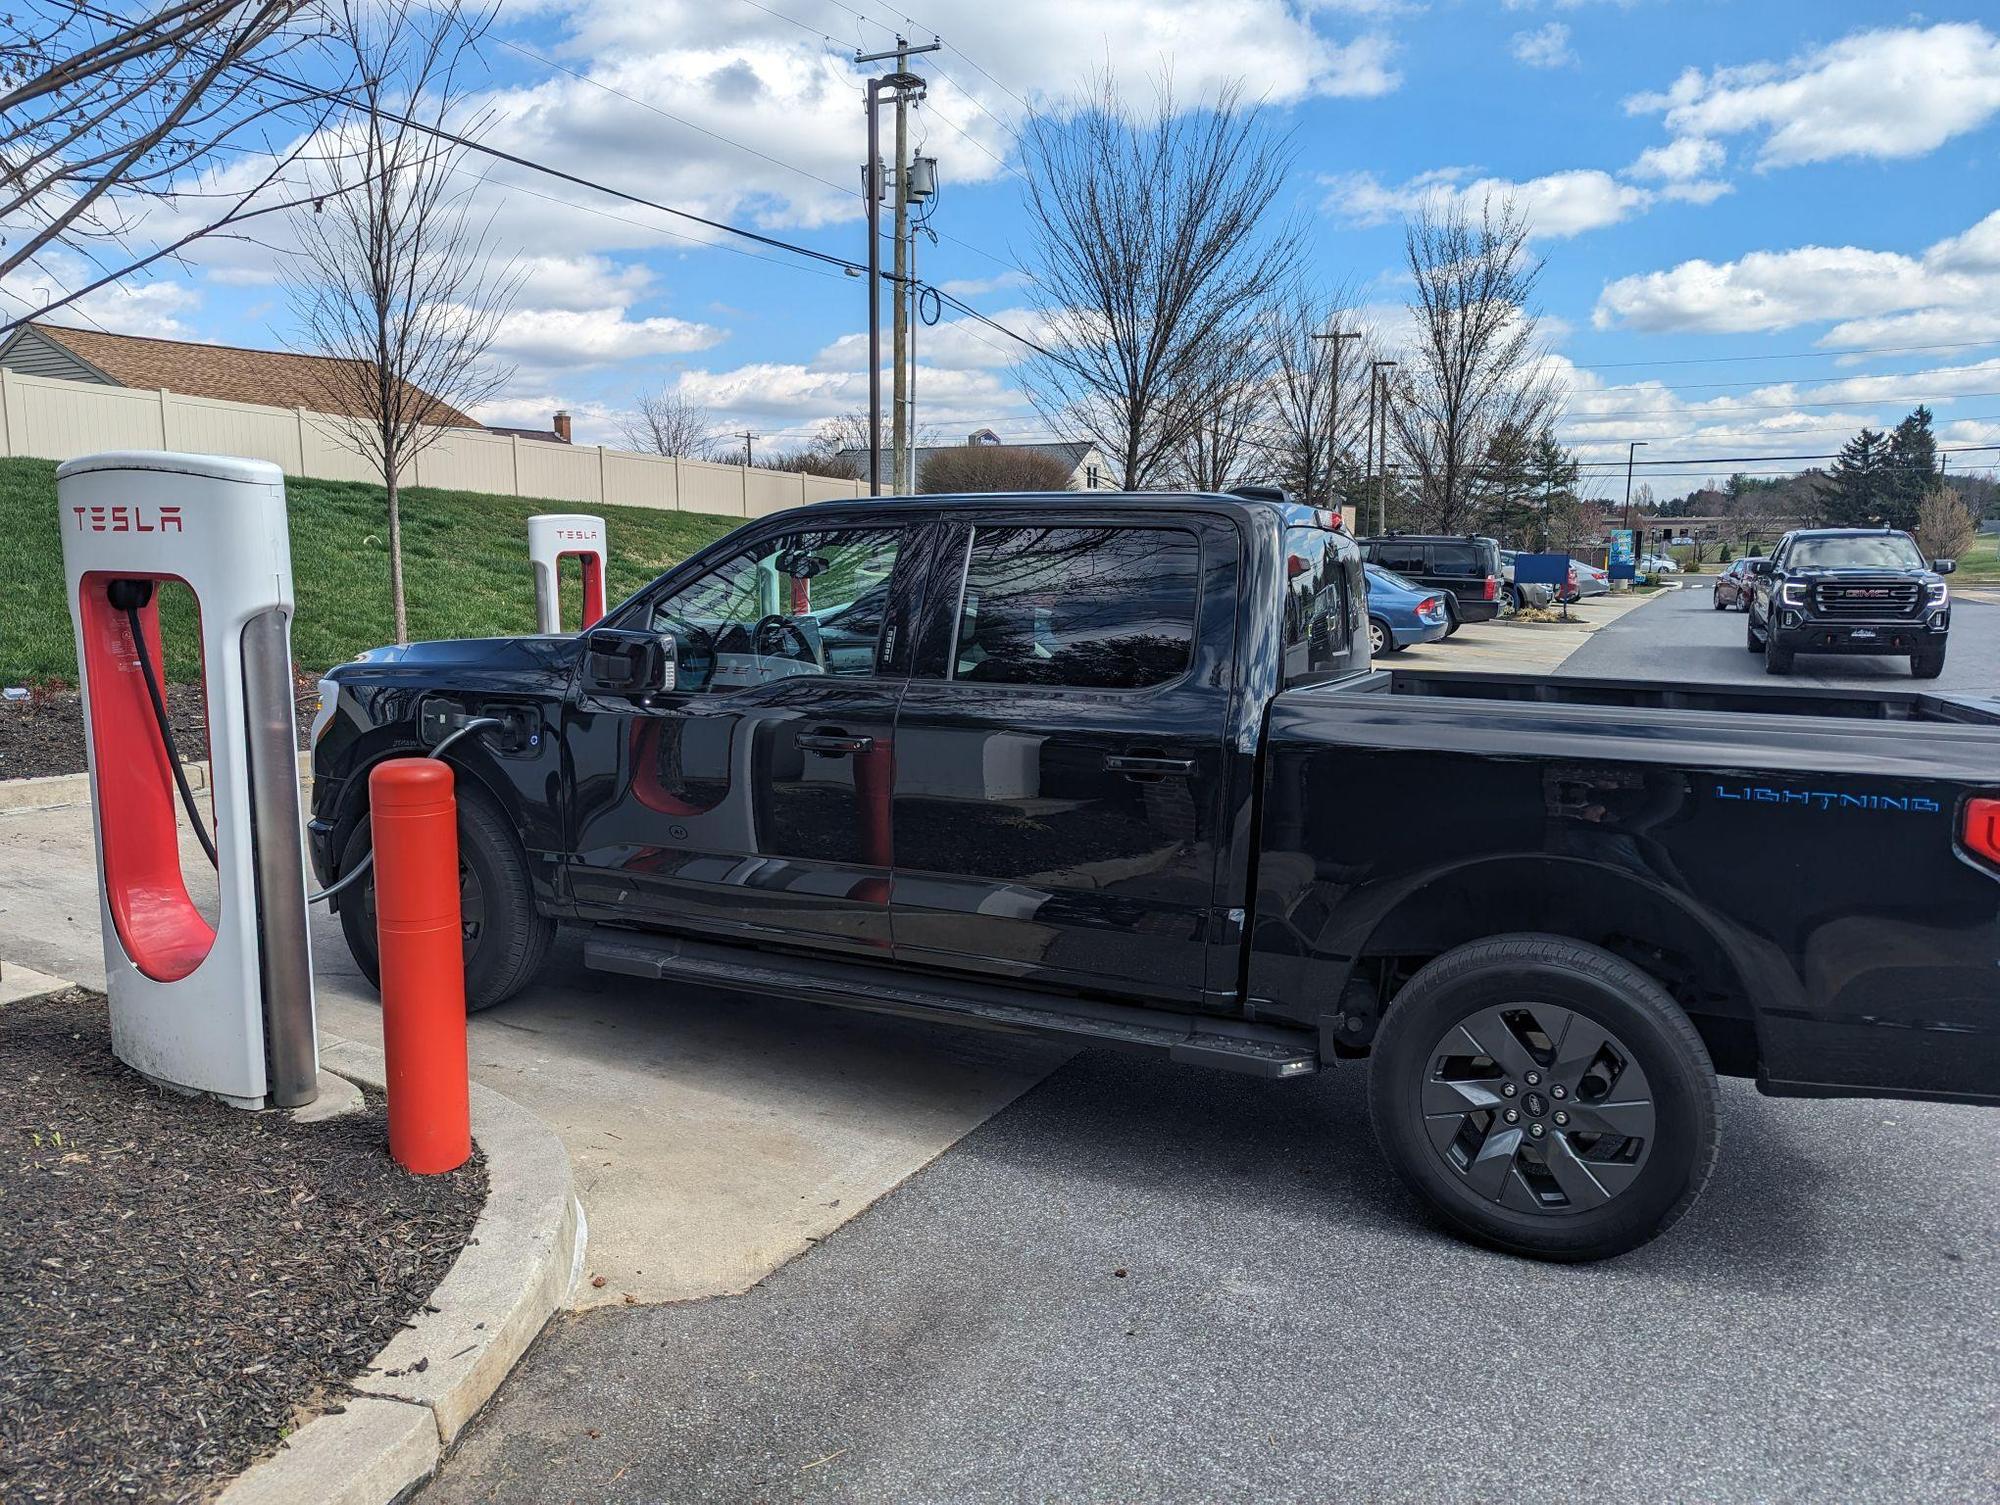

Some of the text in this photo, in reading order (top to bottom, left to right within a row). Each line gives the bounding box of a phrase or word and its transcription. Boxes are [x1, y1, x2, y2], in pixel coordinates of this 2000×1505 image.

[73, 507, 182, 533] TESLA
[556, 530, 597, 540] TESLA
[1845, 589, 1889, 598] GMC
[1716, 786, 1940, 812] LIGHTNING
